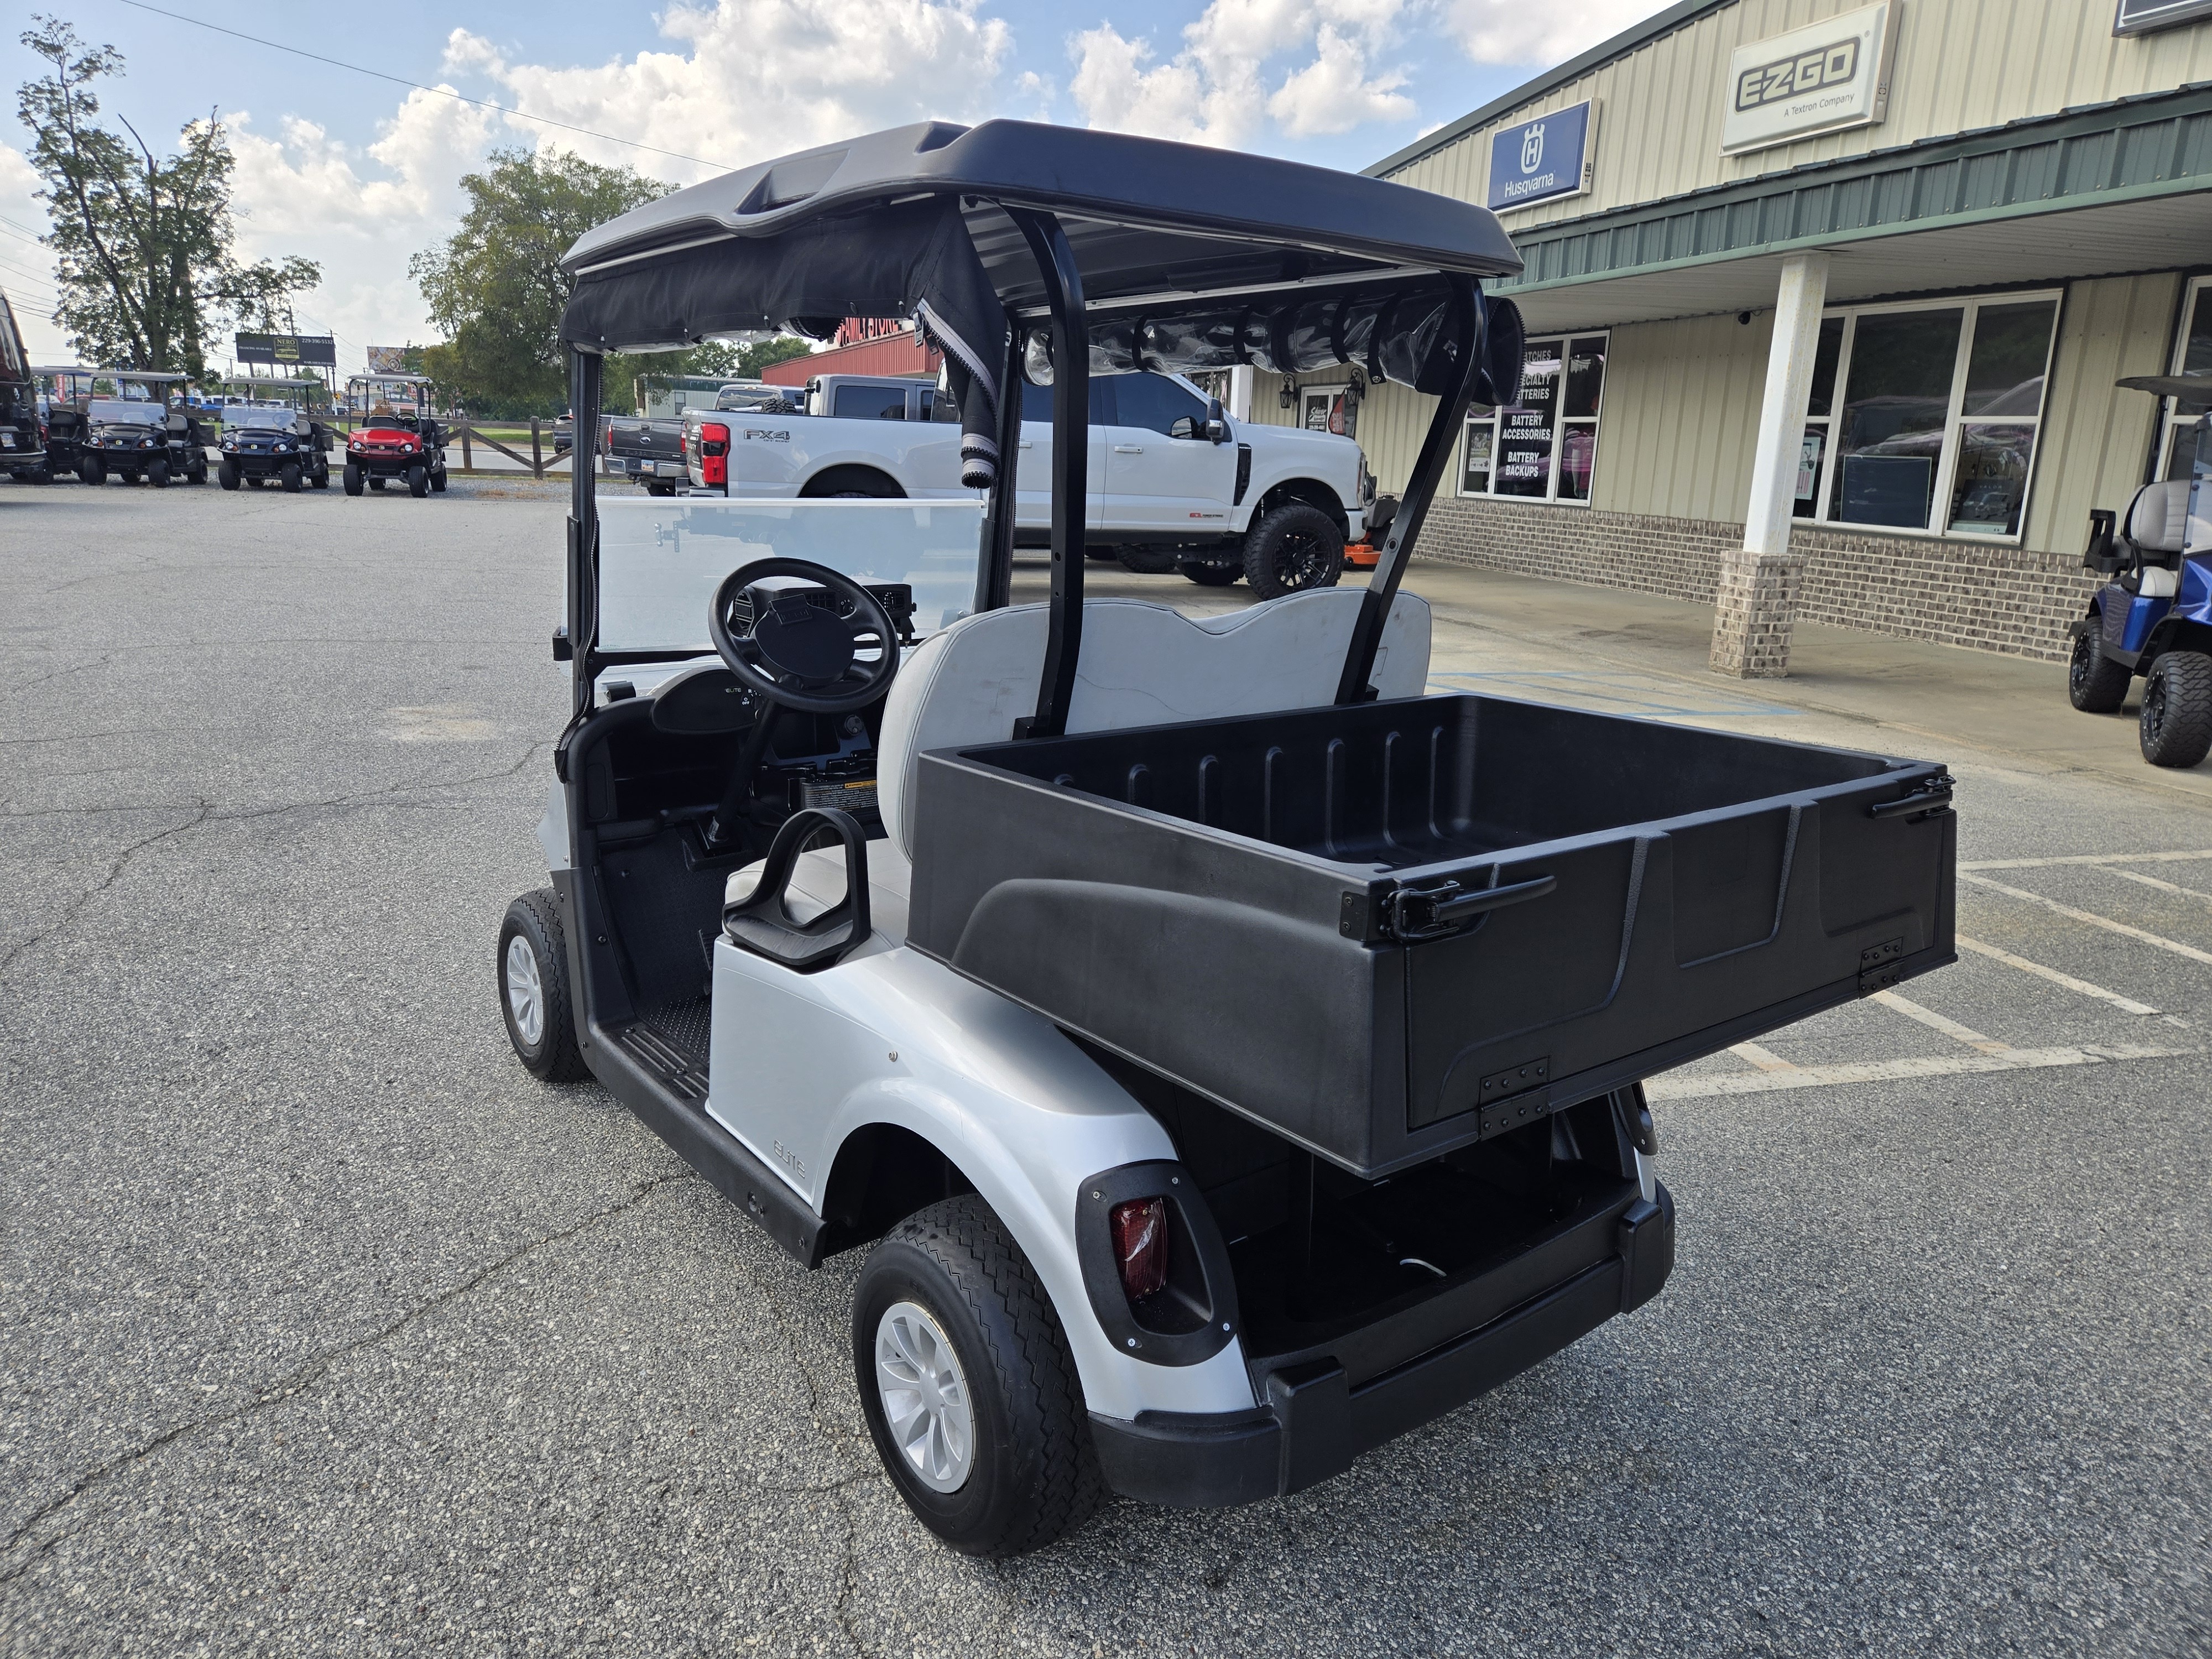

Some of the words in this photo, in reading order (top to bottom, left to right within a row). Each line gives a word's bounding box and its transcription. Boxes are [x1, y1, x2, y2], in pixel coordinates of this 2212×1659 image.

[1784, 108, 1789, 117] A
[1791, 103, 1817, 116] Textron
[1819, 93, 1855, 109] Company
[1505, 173, 1554, 197] Husqvarna
[1521, 374, 1552, 386] ECIALTY
[1516, 388, 1550, 400] ATTERIES
[1511, 415, 1543, 426] BATTERY
[744, 429, 790, 440] FX4
[1502, 429, 1551, 440] ACCESSORIES
[1507, 451, 1540, 463] BATTERY
[1505, 465, 1539, 477] BACKUPS
